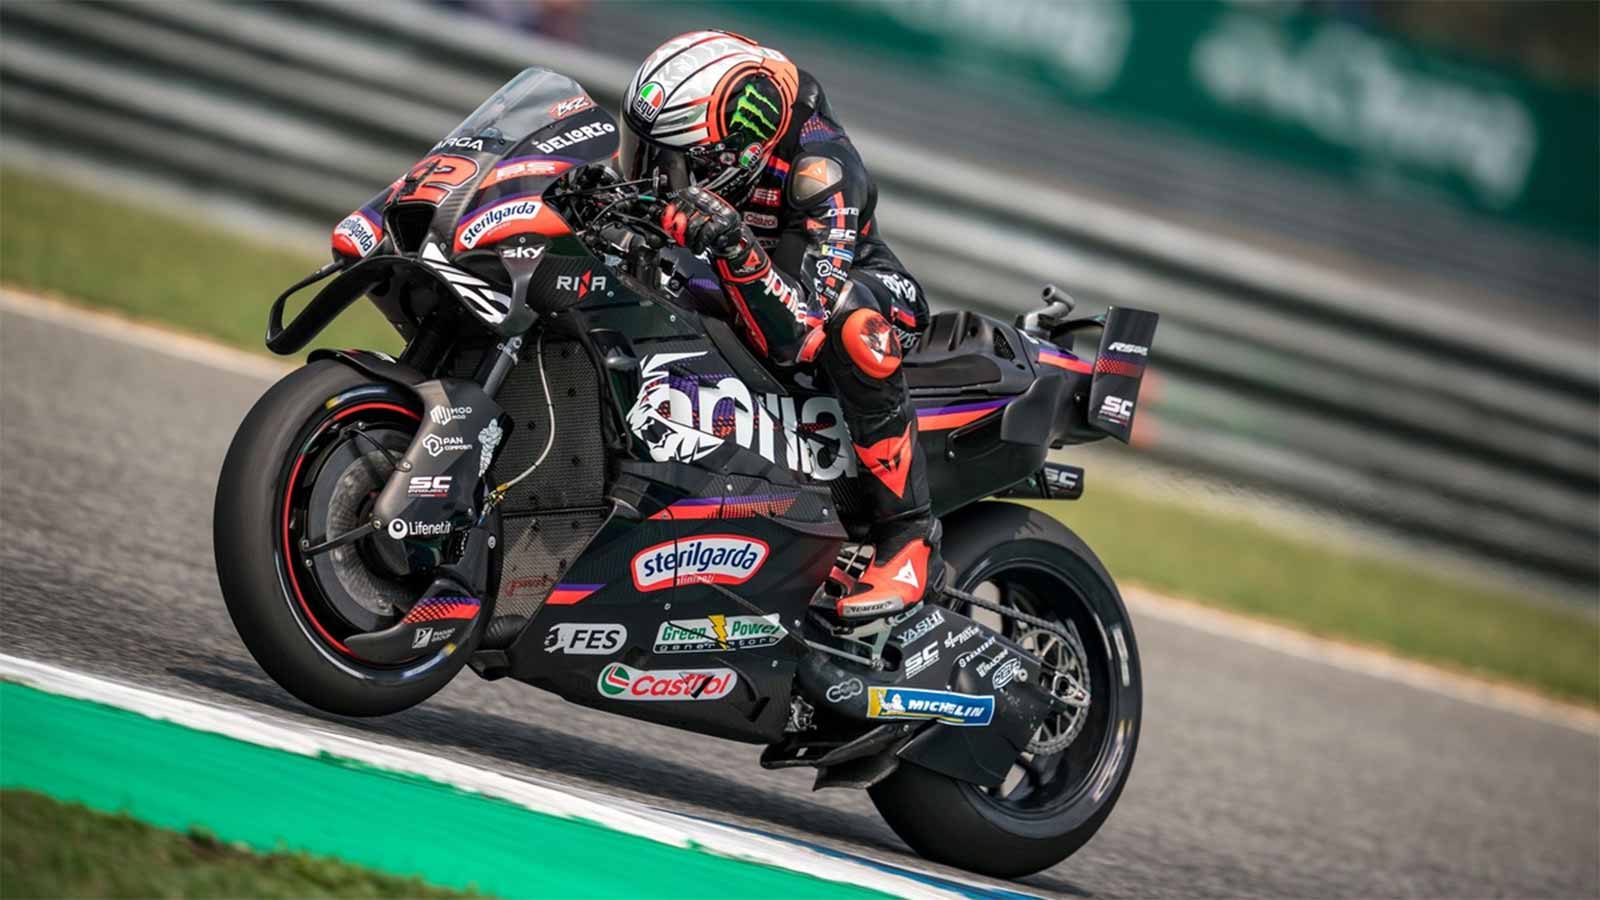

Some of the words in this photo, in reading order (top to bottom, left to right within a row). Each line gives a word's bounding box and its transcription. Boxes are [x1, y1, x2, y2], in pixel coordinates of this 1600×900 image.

[464, 202, 536, 244] sterilgarda
[503, 246, 545, 259] sky
[1101, 395, 1133, 416] SC
[409, 476, 452, 489] SC
[643, 542, 758, 577] sterilgarda
[661, 625, 707, 641] Green
[730, 621, 781, 637] Power
[897, 609, 944, 644] YASHI
[569, 629, 621, 649] FES
[904, 640, 939, 672] SC
[631, 672, 733, 697] Castrol
[908, 699, 985, 717] MICHELIN
